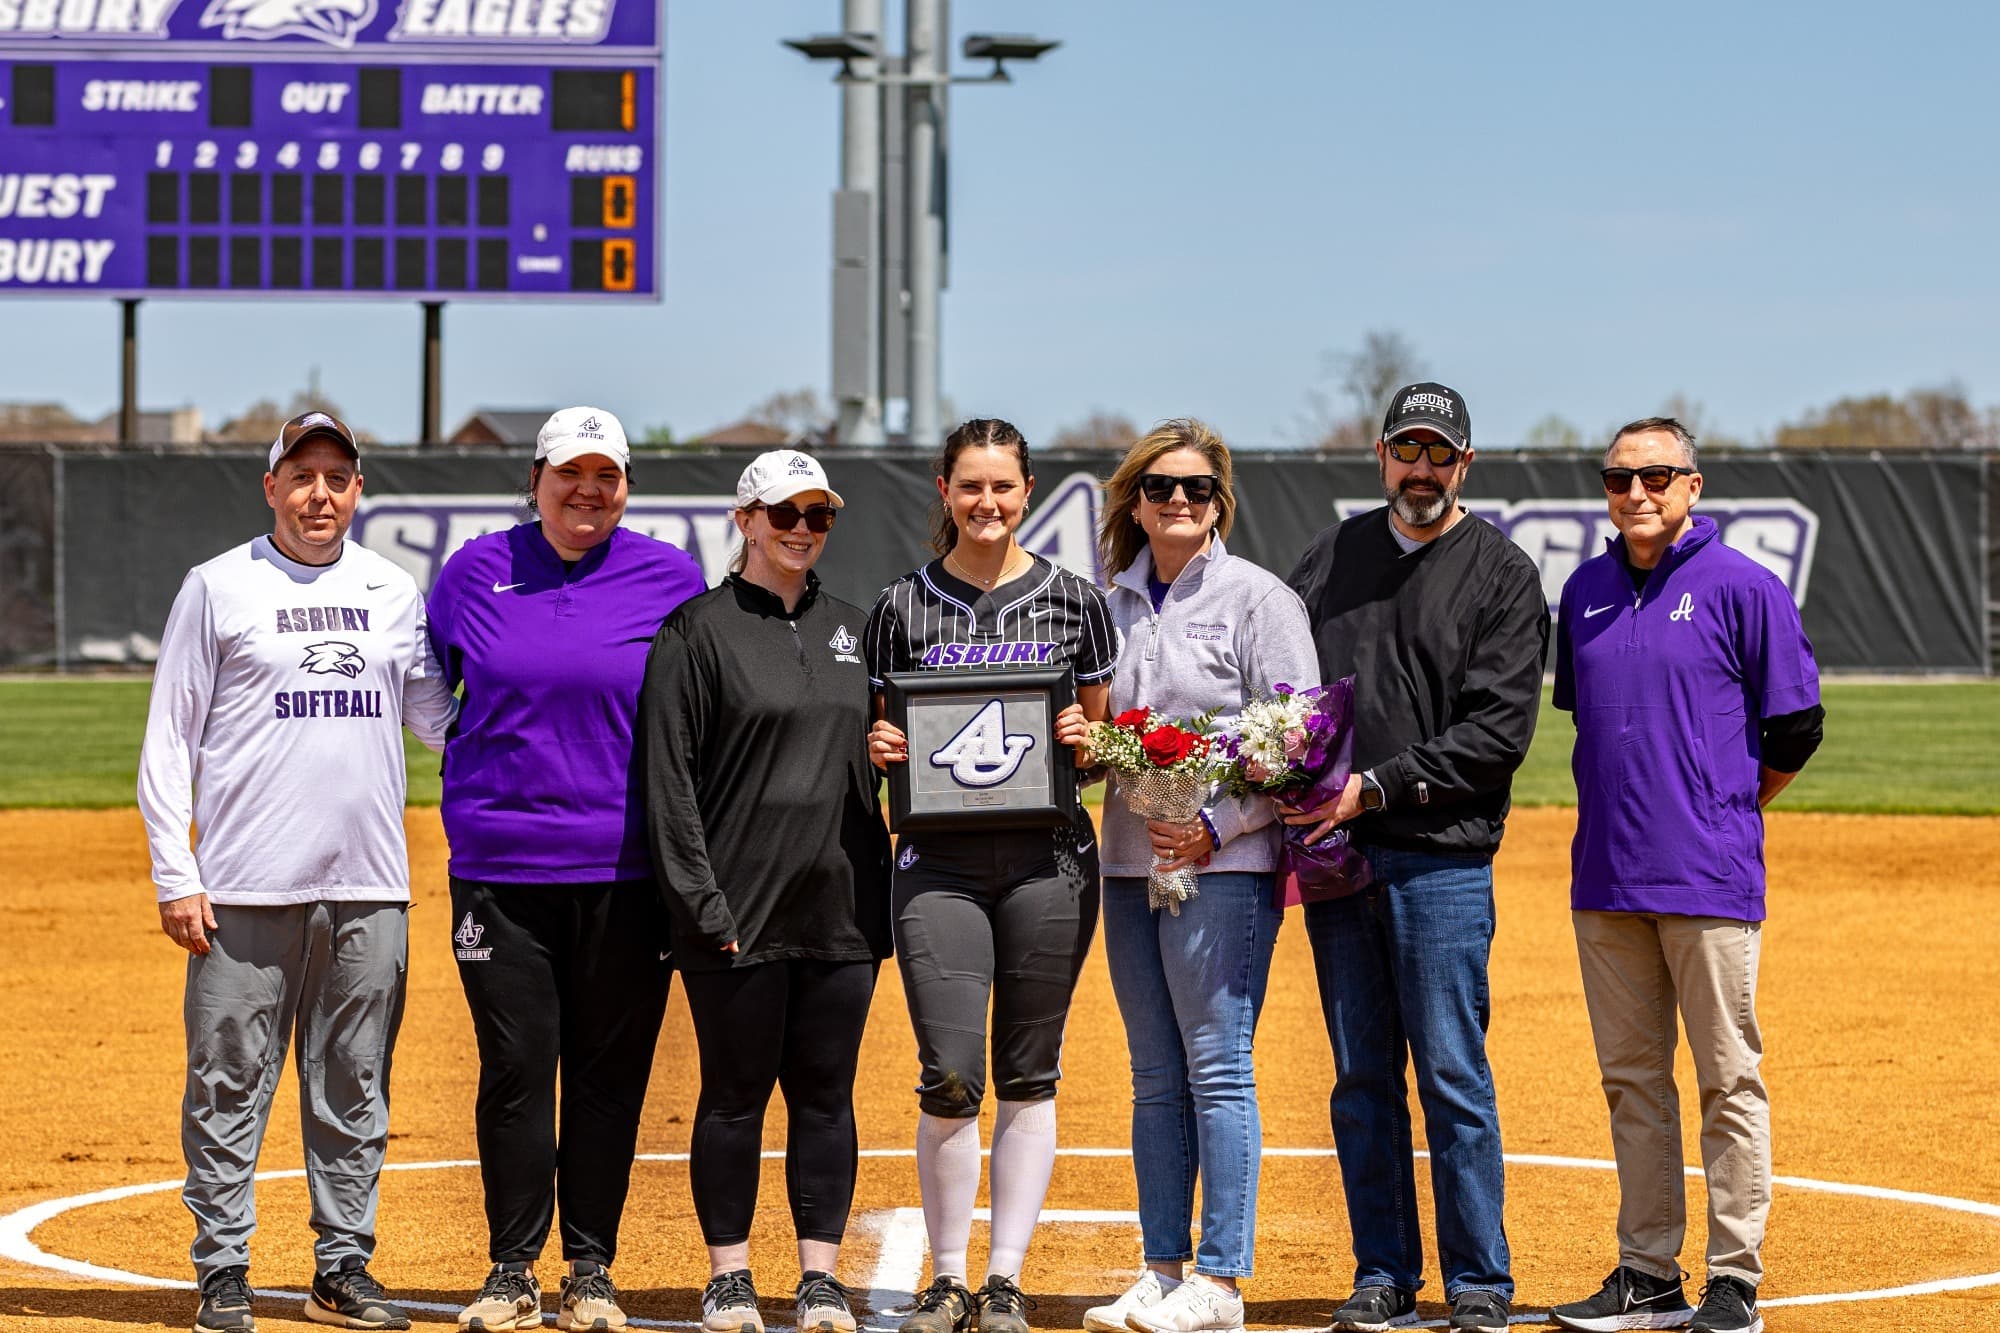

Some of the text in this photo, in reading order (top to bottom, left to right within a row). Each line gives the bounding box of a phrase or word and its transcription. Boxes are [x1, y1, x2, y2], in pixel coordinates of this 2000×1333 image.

[402, 0, 608, 36] EAGLES
[82, 80, 544, 115] STRIKE OUT BATTER
[621, 71, 636, 130] 1
[156, 140, 643, 172] 1 2 3 4 5 6 7 8 9 RUNS
[603, 175, 636, 229] 0
[603, 238, 636, 291] 0
[1402, 393, 1453, 410] ASBURY
[276, 606, 370, 633] ASBURY
[920, 641, 1059, 667] ASBURY
[275, 690, 382, 719] SOFTBALL
